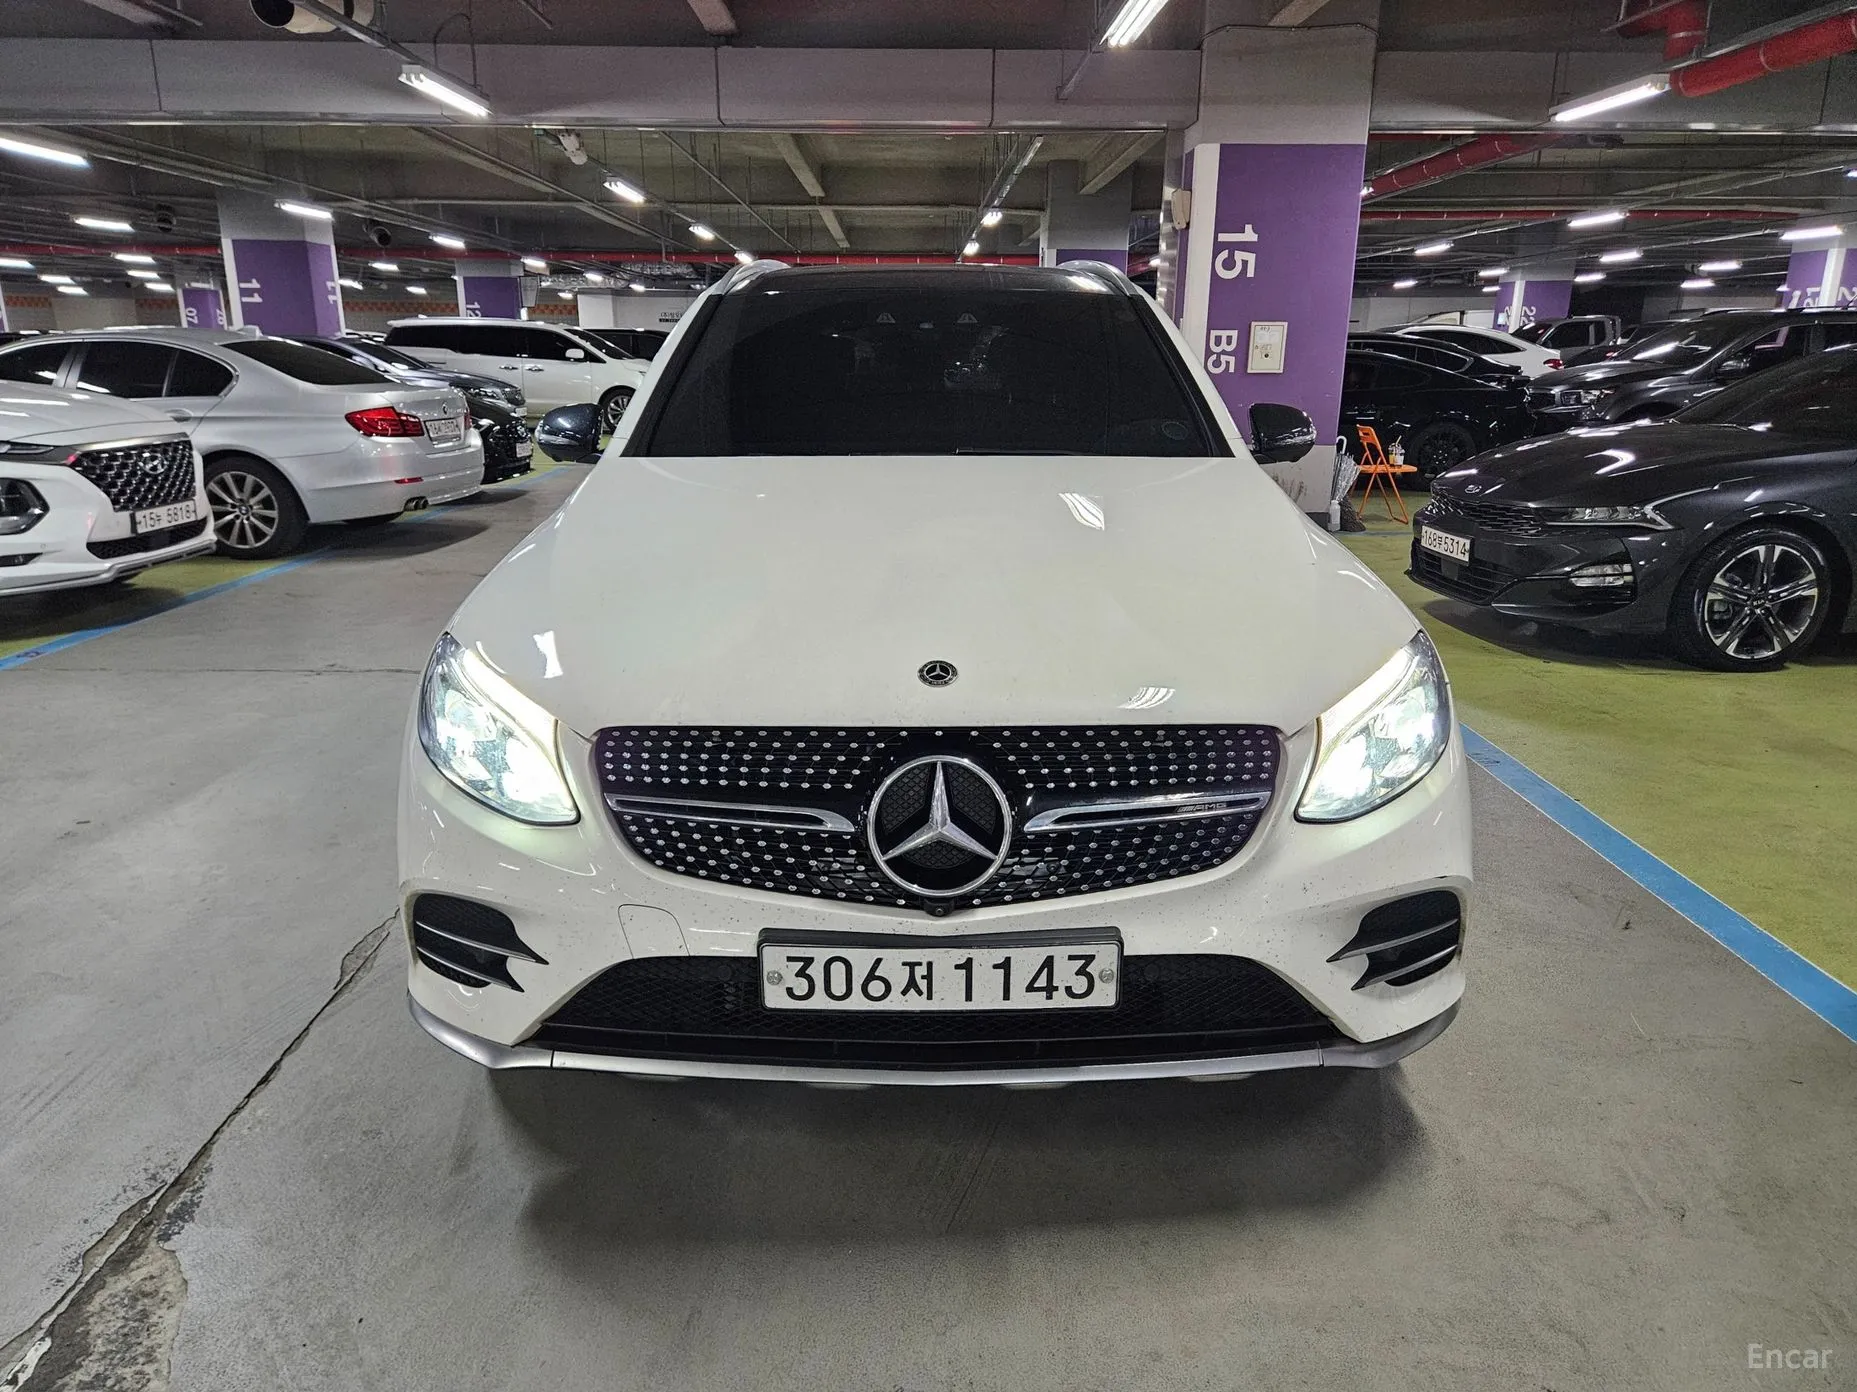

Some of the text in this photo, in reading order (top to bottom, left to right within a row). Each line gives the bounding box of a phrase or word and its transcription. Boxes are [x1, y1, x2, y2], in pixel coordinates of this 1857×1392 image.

[1214, 224, 1259, 280] 15
[239, 278, 263, 303] 11
[185, 307, 199, 324] 07
[1207, 329, 1239, 375] B5
[1193, 802, 1227, 811] AMG
